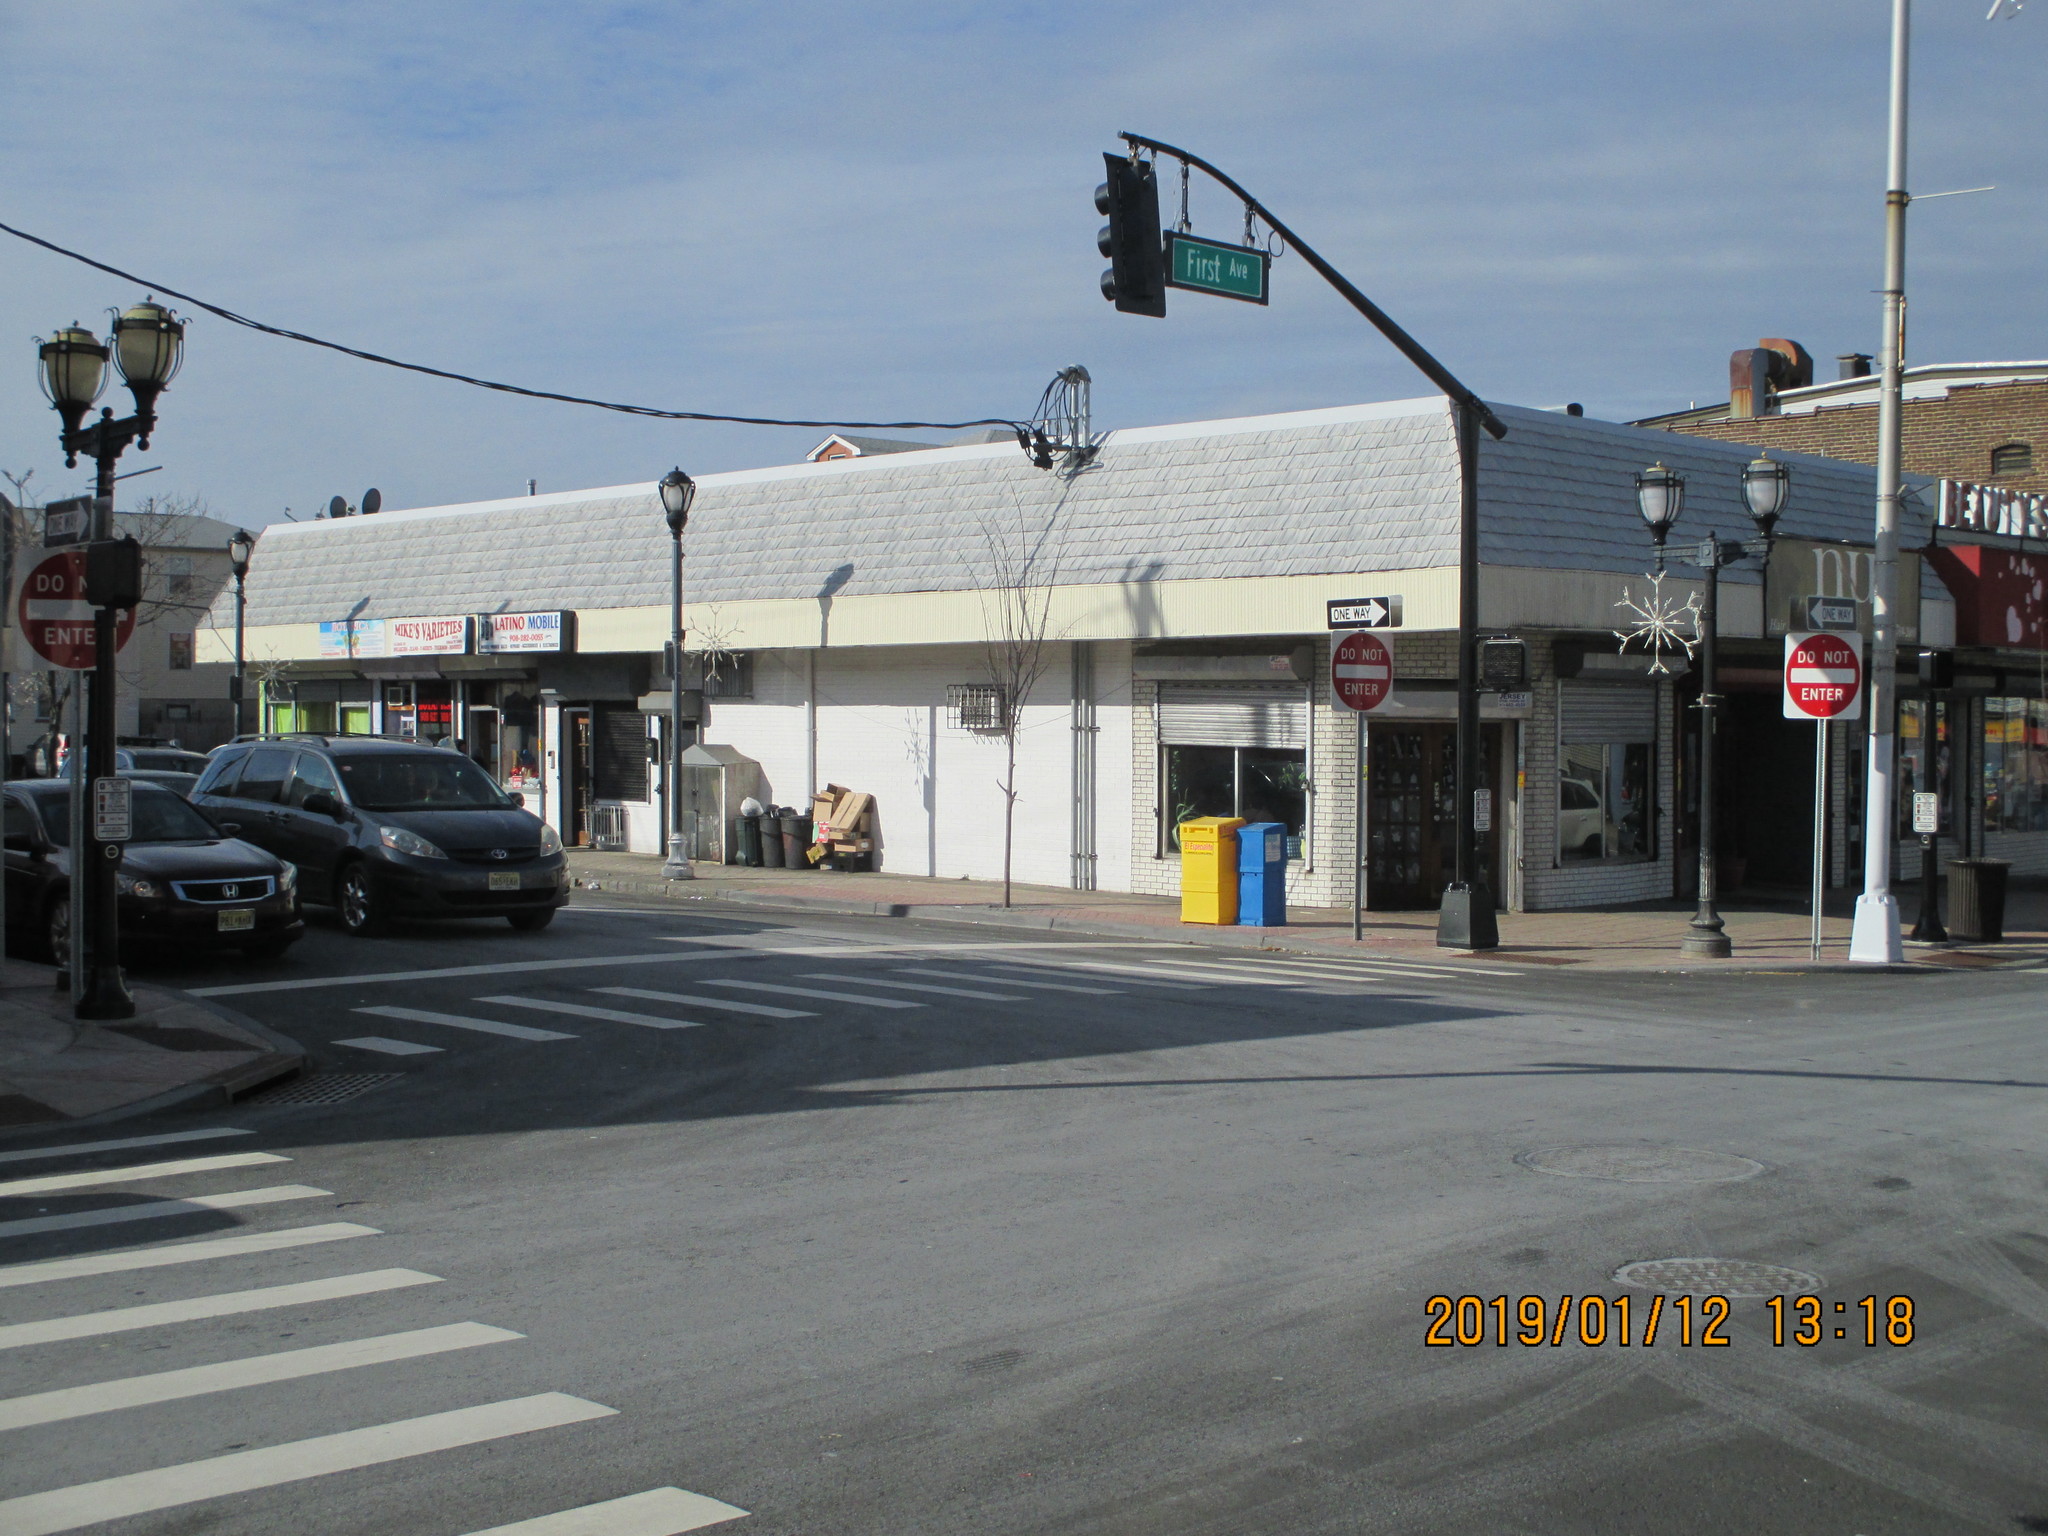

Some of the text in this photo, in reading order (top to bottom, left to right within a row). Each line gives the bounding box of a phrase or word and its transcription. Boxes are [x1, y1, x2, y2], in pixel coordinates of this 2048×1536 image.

[1187, 248, 1248, 283] First Ave
[37, 574, 64, 592] DO
[1333, 607, 1371, 621] ONE WAY
[1822, 607, 1852, 621] ONE WAY
[495, 615, 559, 631] LATINO MOBILE
[395, 620, 463, 641] MIKE'S VARIETIES
[1341, 648, 1384, 660] DO NOT
[1798, 650, 1849, 664] DO NOT
[1344, 682, 1379, 696] ENTER
[1801, 687, 1843, 701] ENTER
